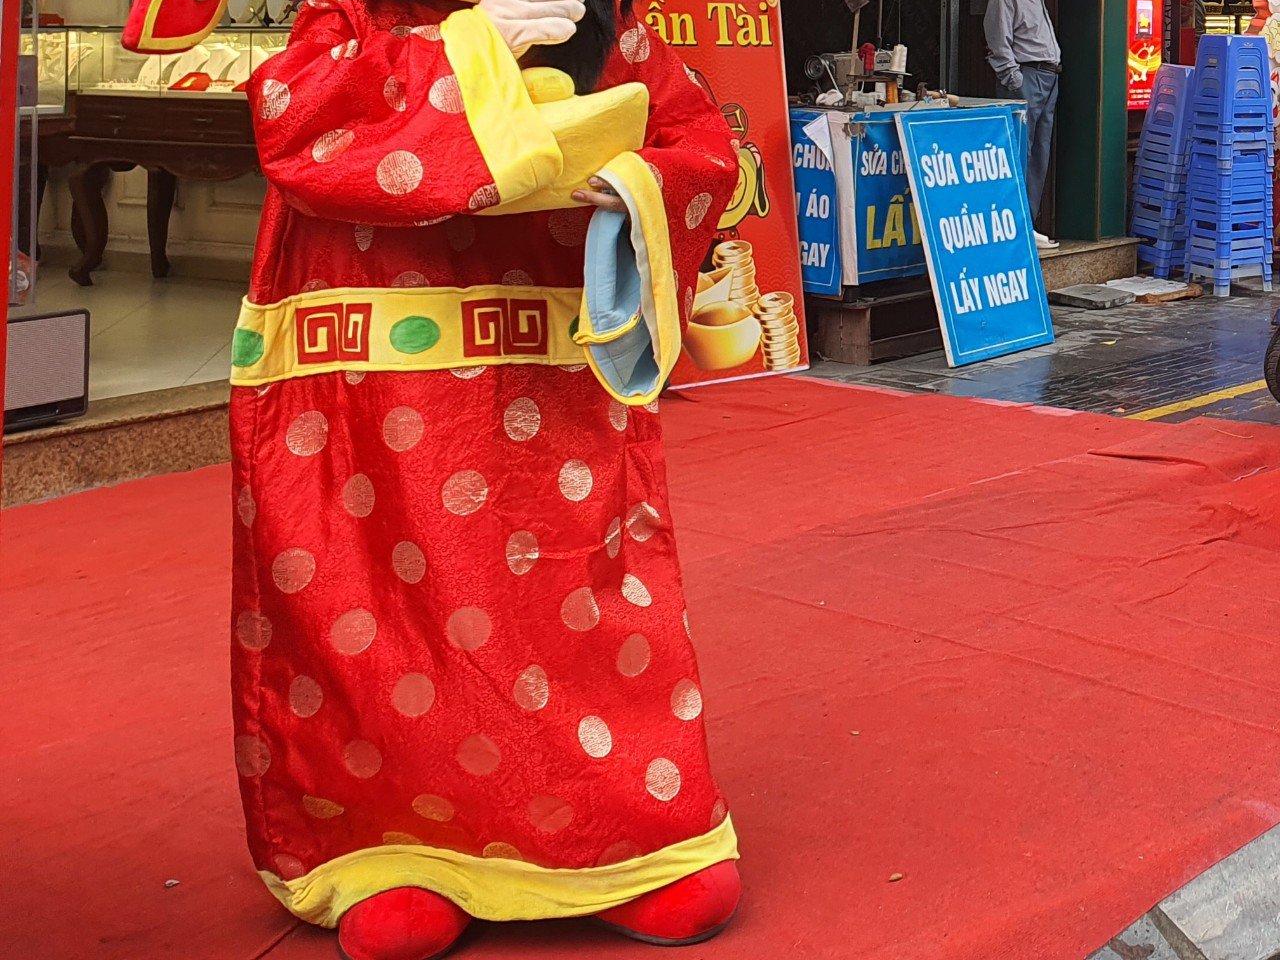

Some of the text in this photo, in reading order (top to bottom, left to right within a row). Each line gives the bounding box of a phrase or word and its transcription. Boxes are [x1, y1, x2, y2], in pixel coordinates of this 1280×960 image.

[707, 1, 773, 47] Tài
[861, 143, 887, 176] SỬA
[920, 142, 1013, 188] SỬA CHỮA
[805, 188, 830, 219] ÁO
[938, 203, 1017, 254] QUẦN ÁO
[800, 241, 830, 268] GAY
[950, 267, 1030, 315] LẤY NGAY
